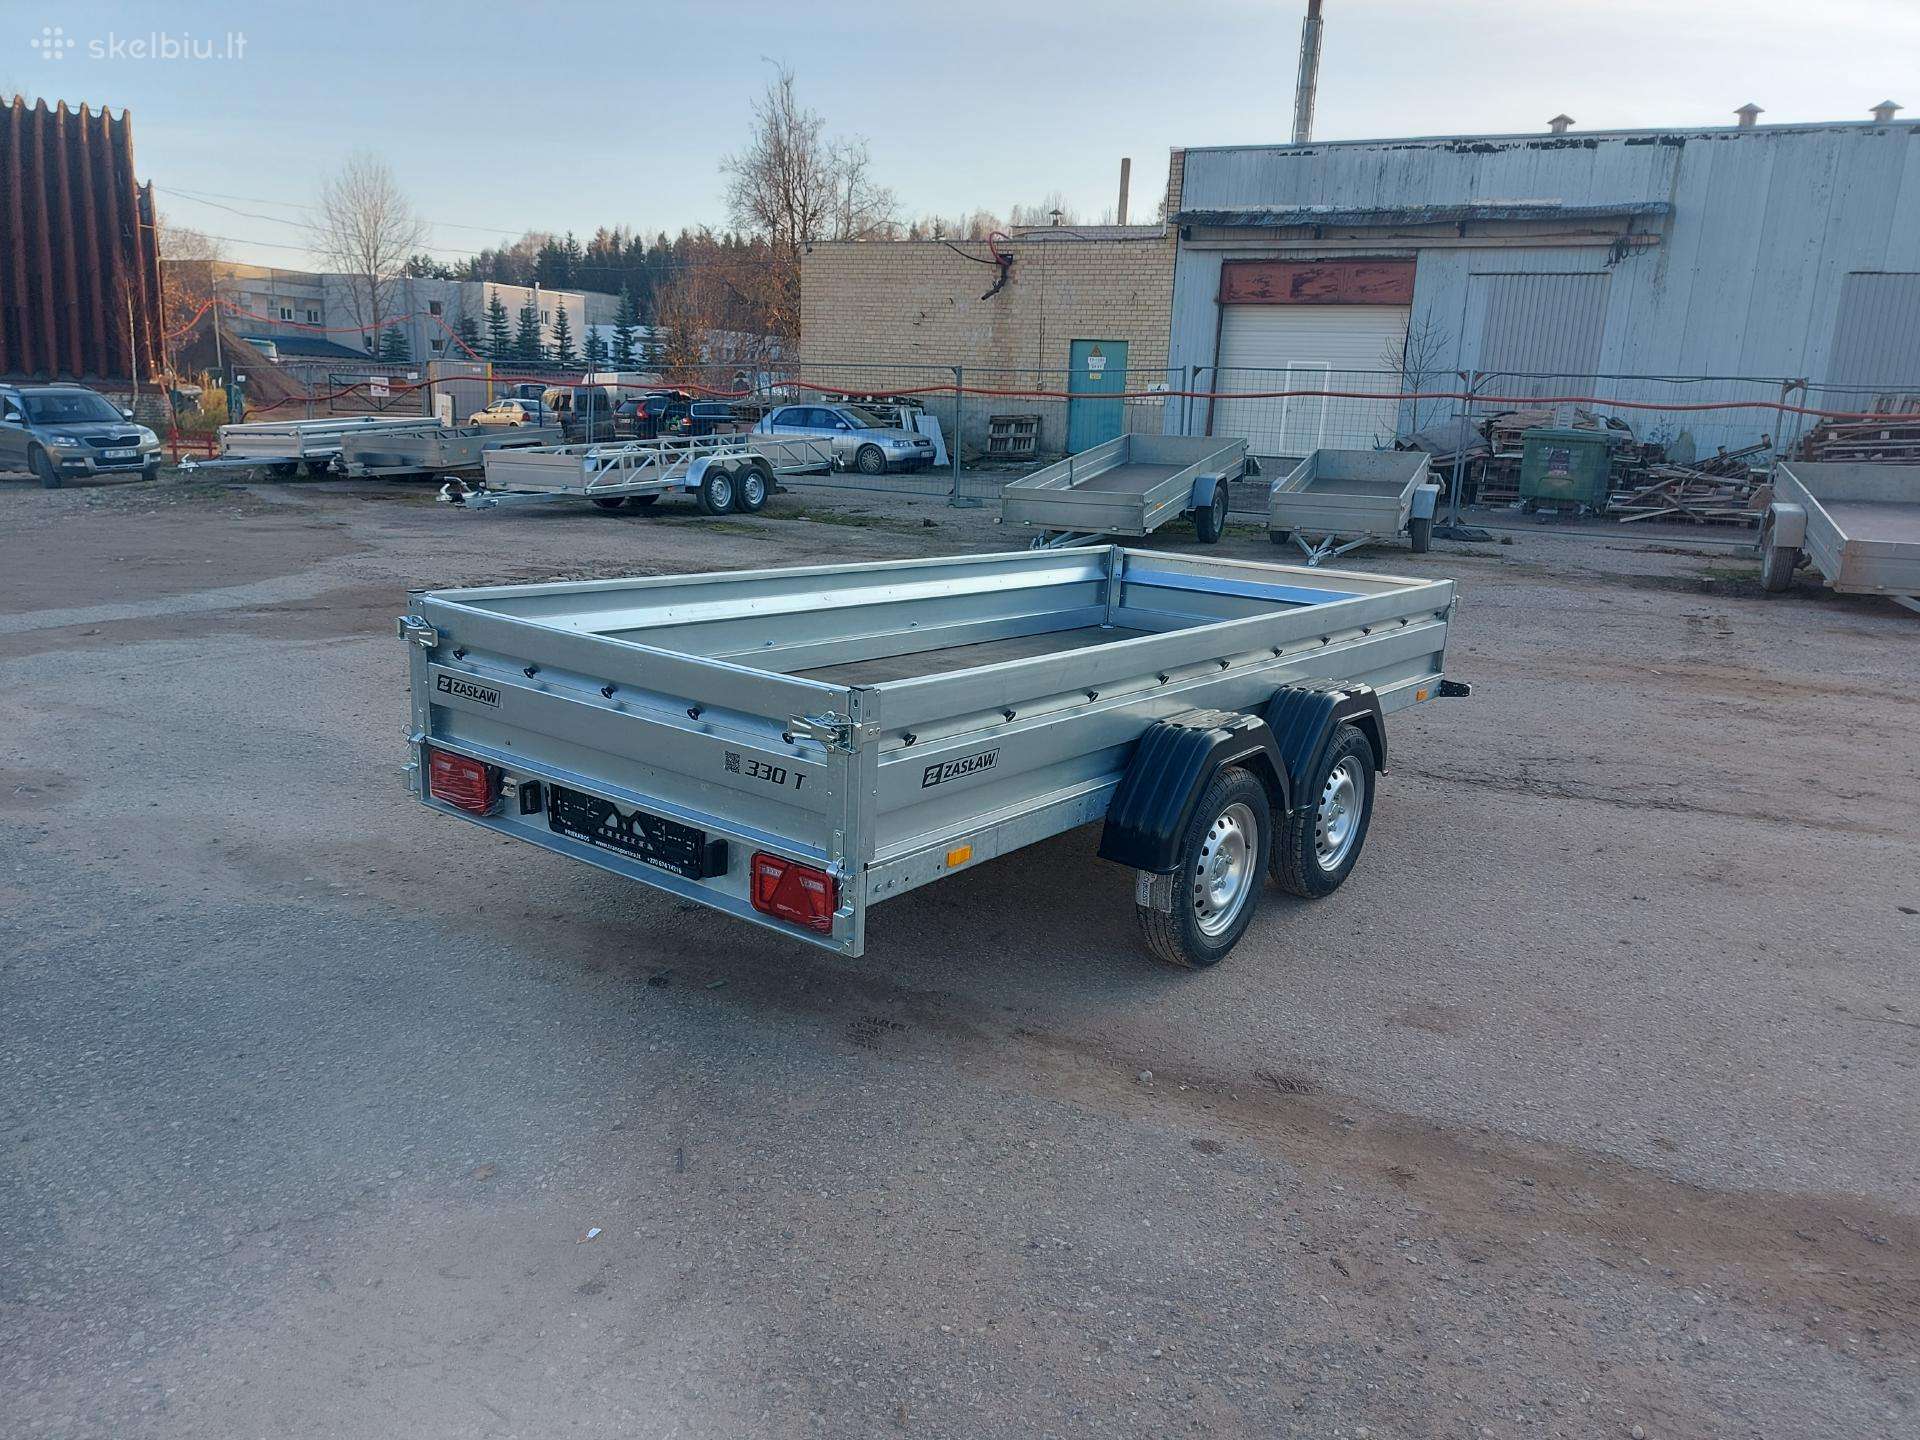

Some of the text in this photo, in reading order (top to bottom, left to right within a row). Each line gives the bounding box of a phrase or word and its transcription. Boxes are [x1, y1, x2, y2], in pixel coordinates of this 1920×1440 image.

[453, 681, 498, 704] ZASŁAW
[744, 759, 807, 790] 330 T
[943, 752, 996, 778] ZASŁAW
